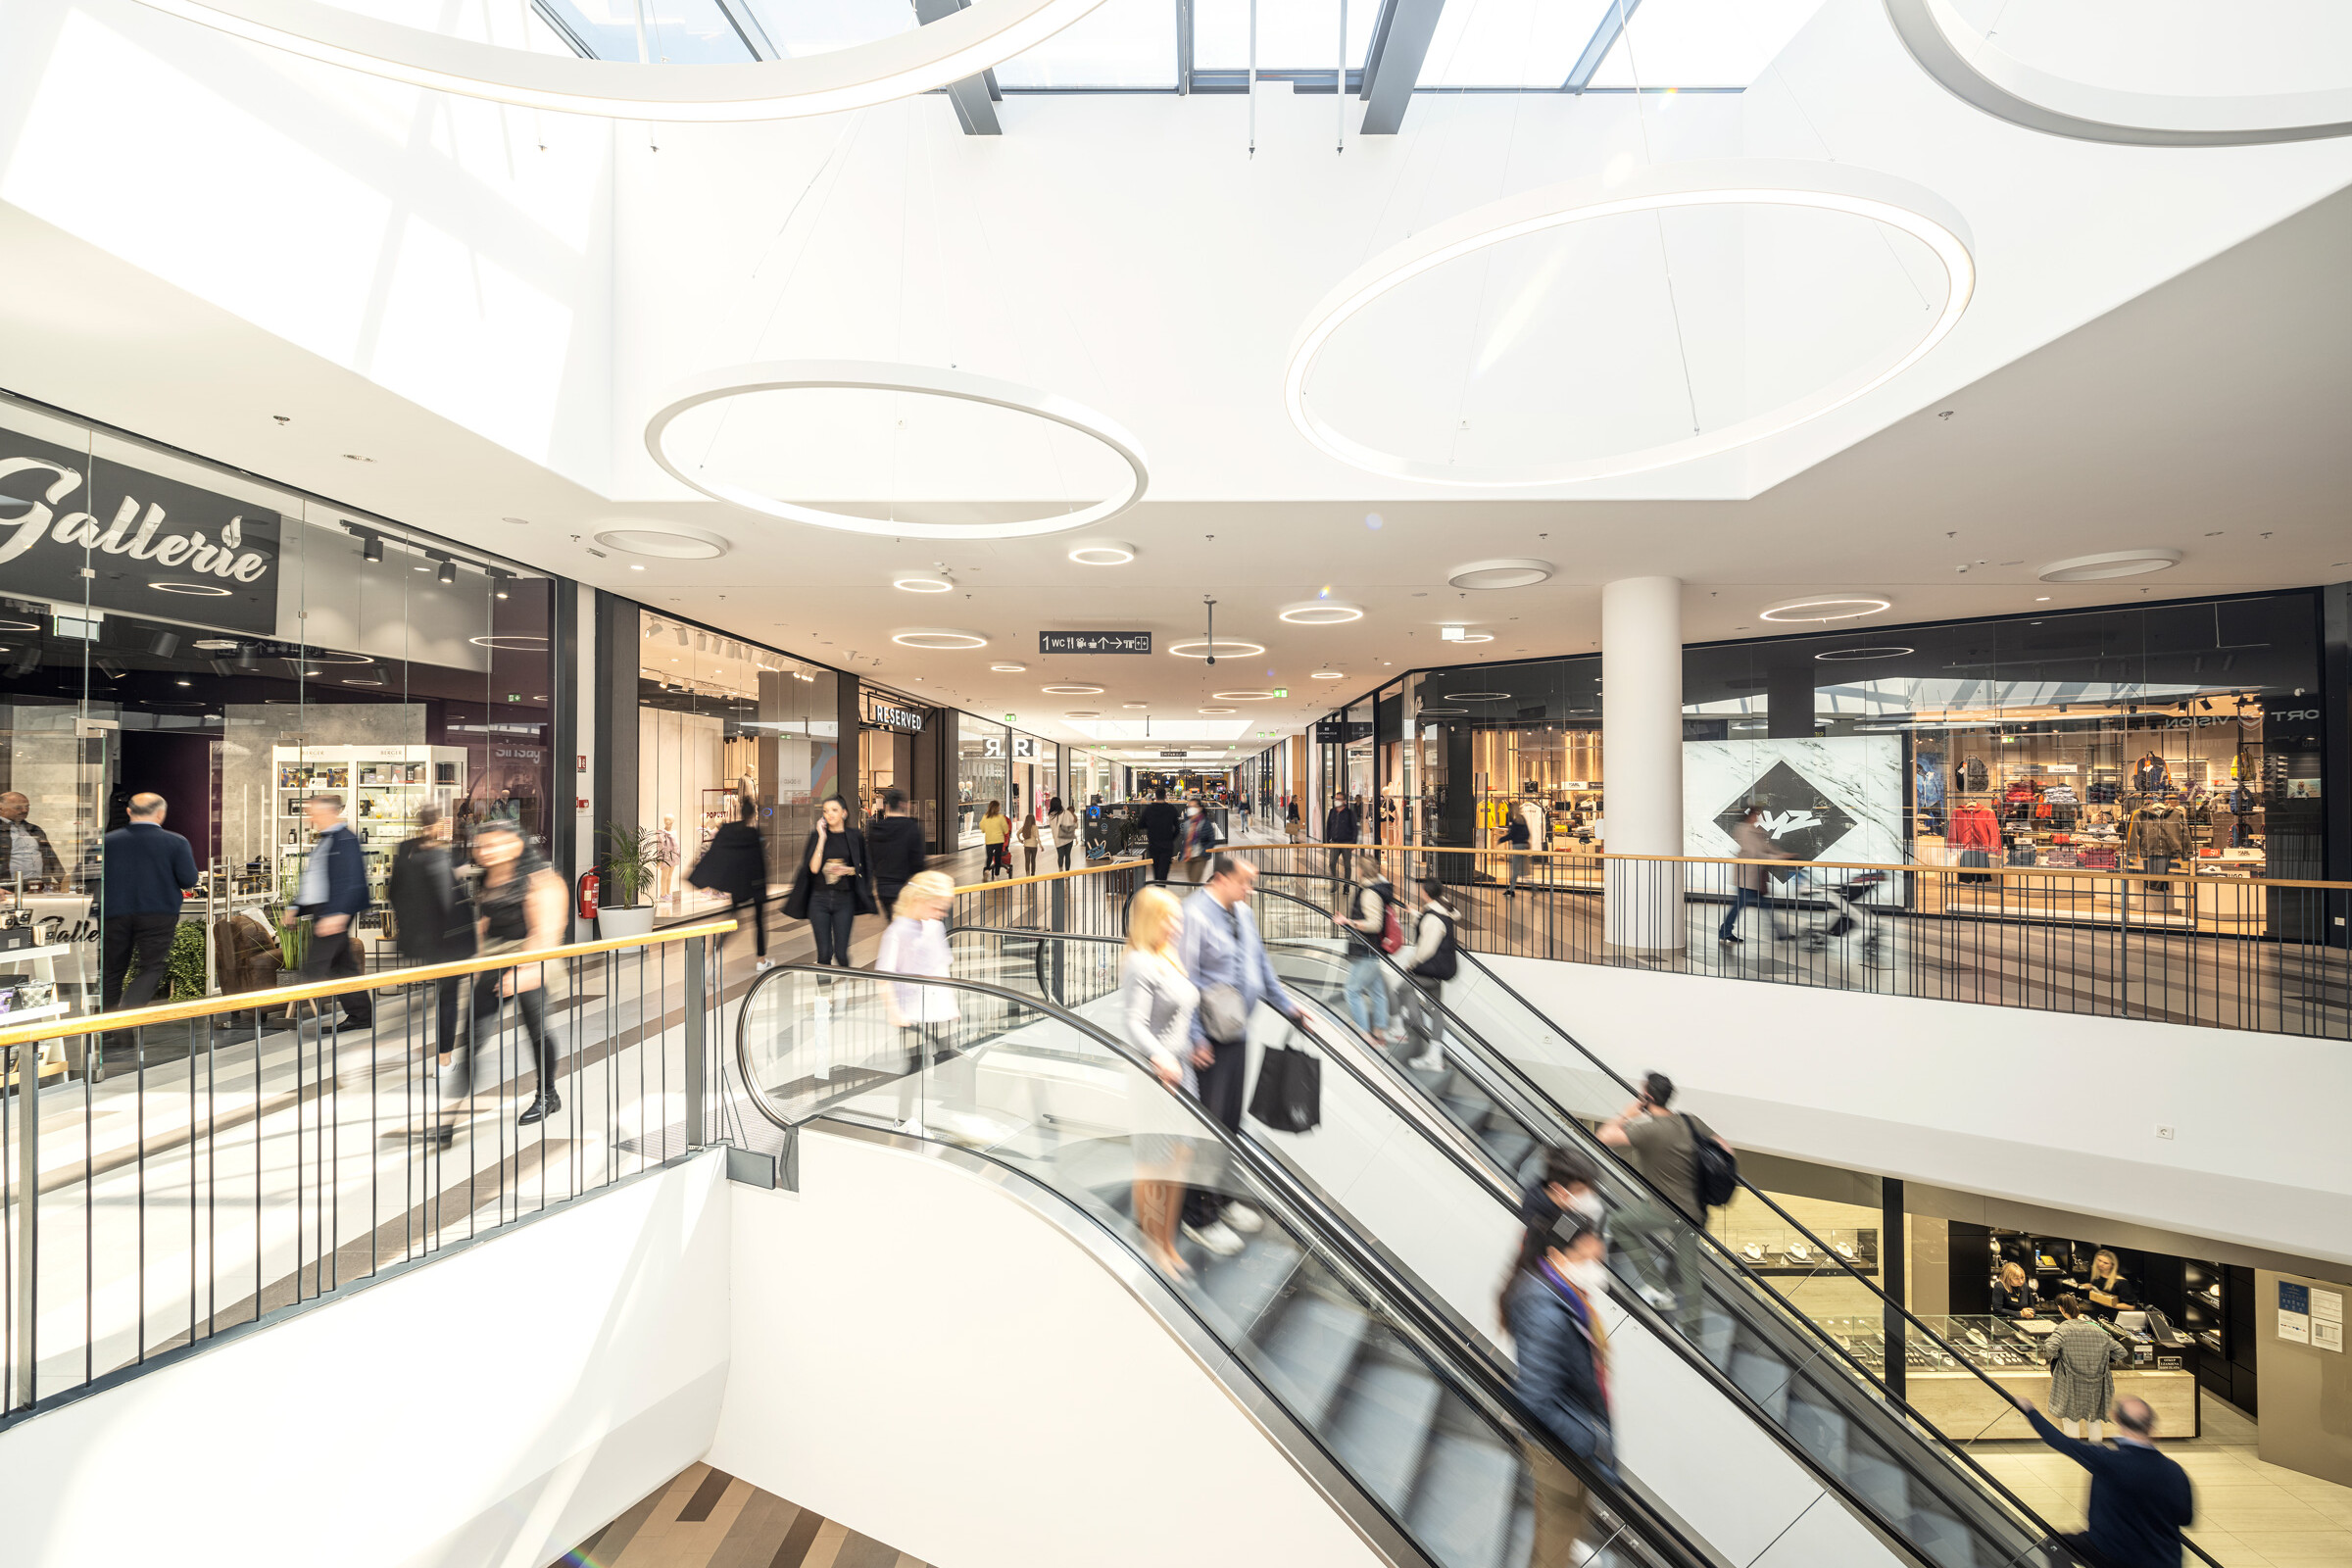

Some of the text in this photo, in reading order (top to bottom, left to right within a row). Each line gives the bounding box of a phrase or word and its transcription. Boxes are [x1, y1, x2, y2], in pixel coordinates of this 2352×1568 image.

[0, 457, 267, 582] Gallerie
[1052, 639, 1065, 648] WC
[876, 705, 922, 730] RESERVED
